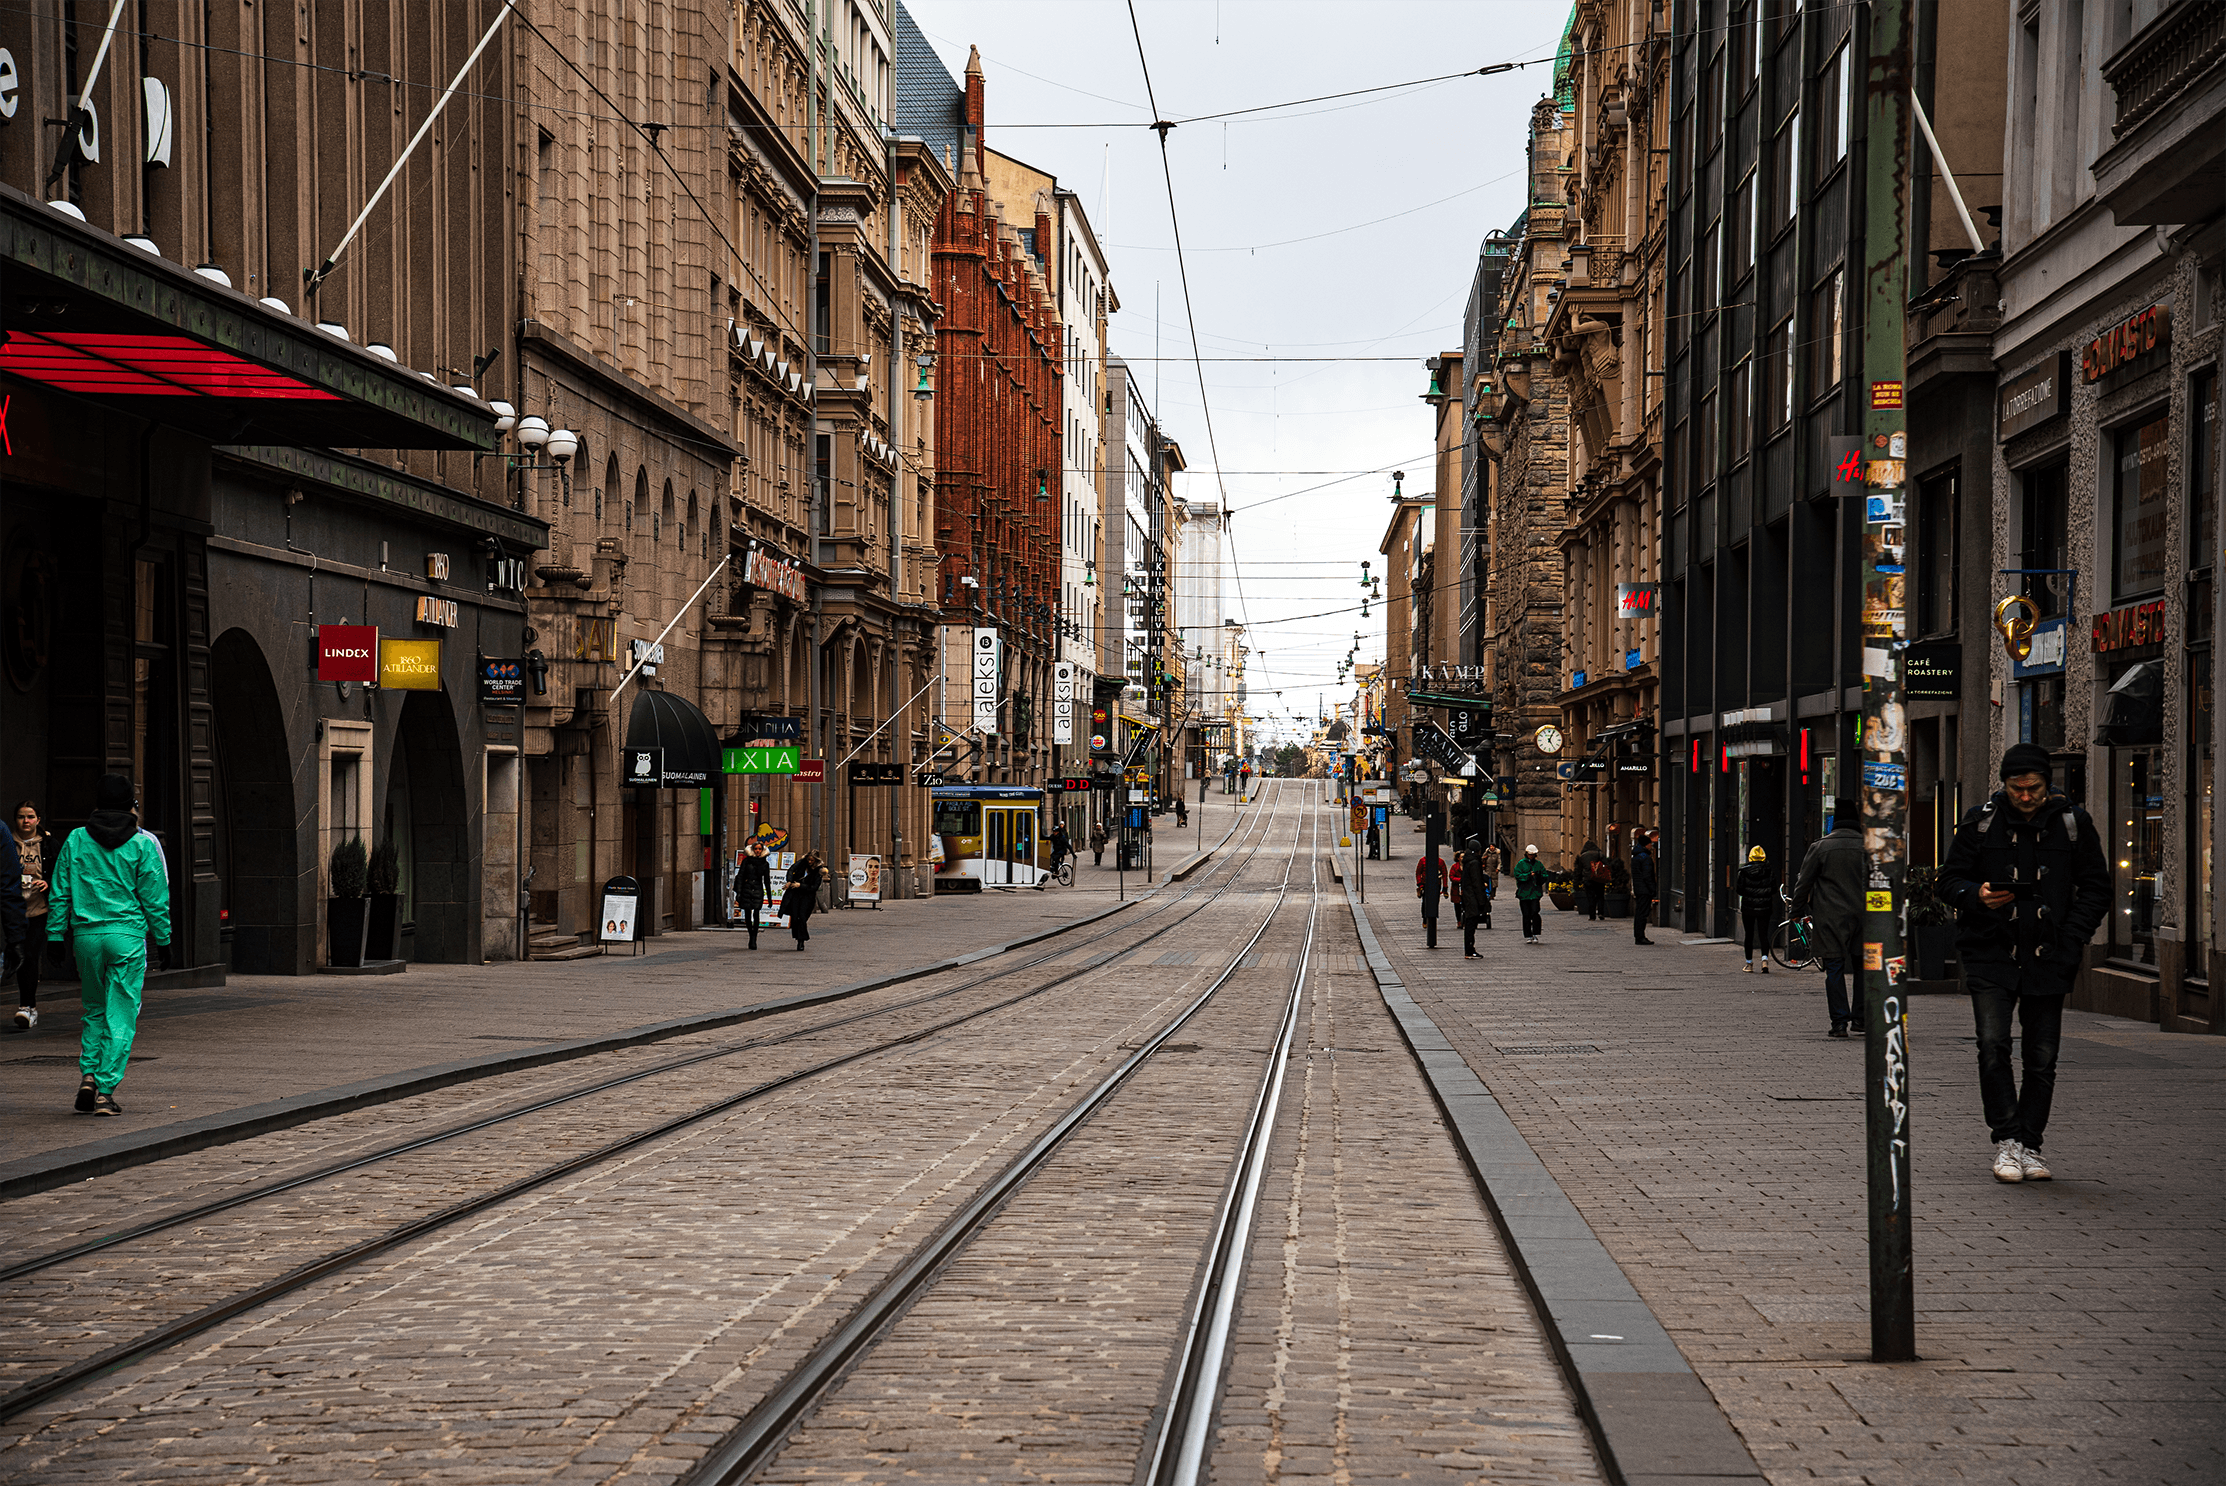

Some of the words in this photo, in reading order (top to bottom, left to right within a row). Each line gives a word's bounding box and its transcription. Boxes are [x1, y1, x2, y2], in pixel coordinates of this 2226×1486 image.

[2082, 305, 2157, 385] HOLMASTO
[1836, 449, 1864, 482] H&
[1622, 590, 1651, 610] H&M
[2091, 600, 2165, 653] HOLMASTO
[325, 648, 370, 658] LINDEX
[400, 656, 422, 664] 1860
[1907, 657, 1931, 666] CAFÉ
[975, 651, 995, 713] aleksi
[1055, 681, 1071, 728] aleksi
[765, 722, 795, 734] PIHA
[1458, 711, 1468, 733] GLO
[662, 771, 707, 780] SUOMALAINEN
[923, 774, 943, 785] Zio
[937, 801, 942, 812] 7
[18, 855, 41, 863] ASA
